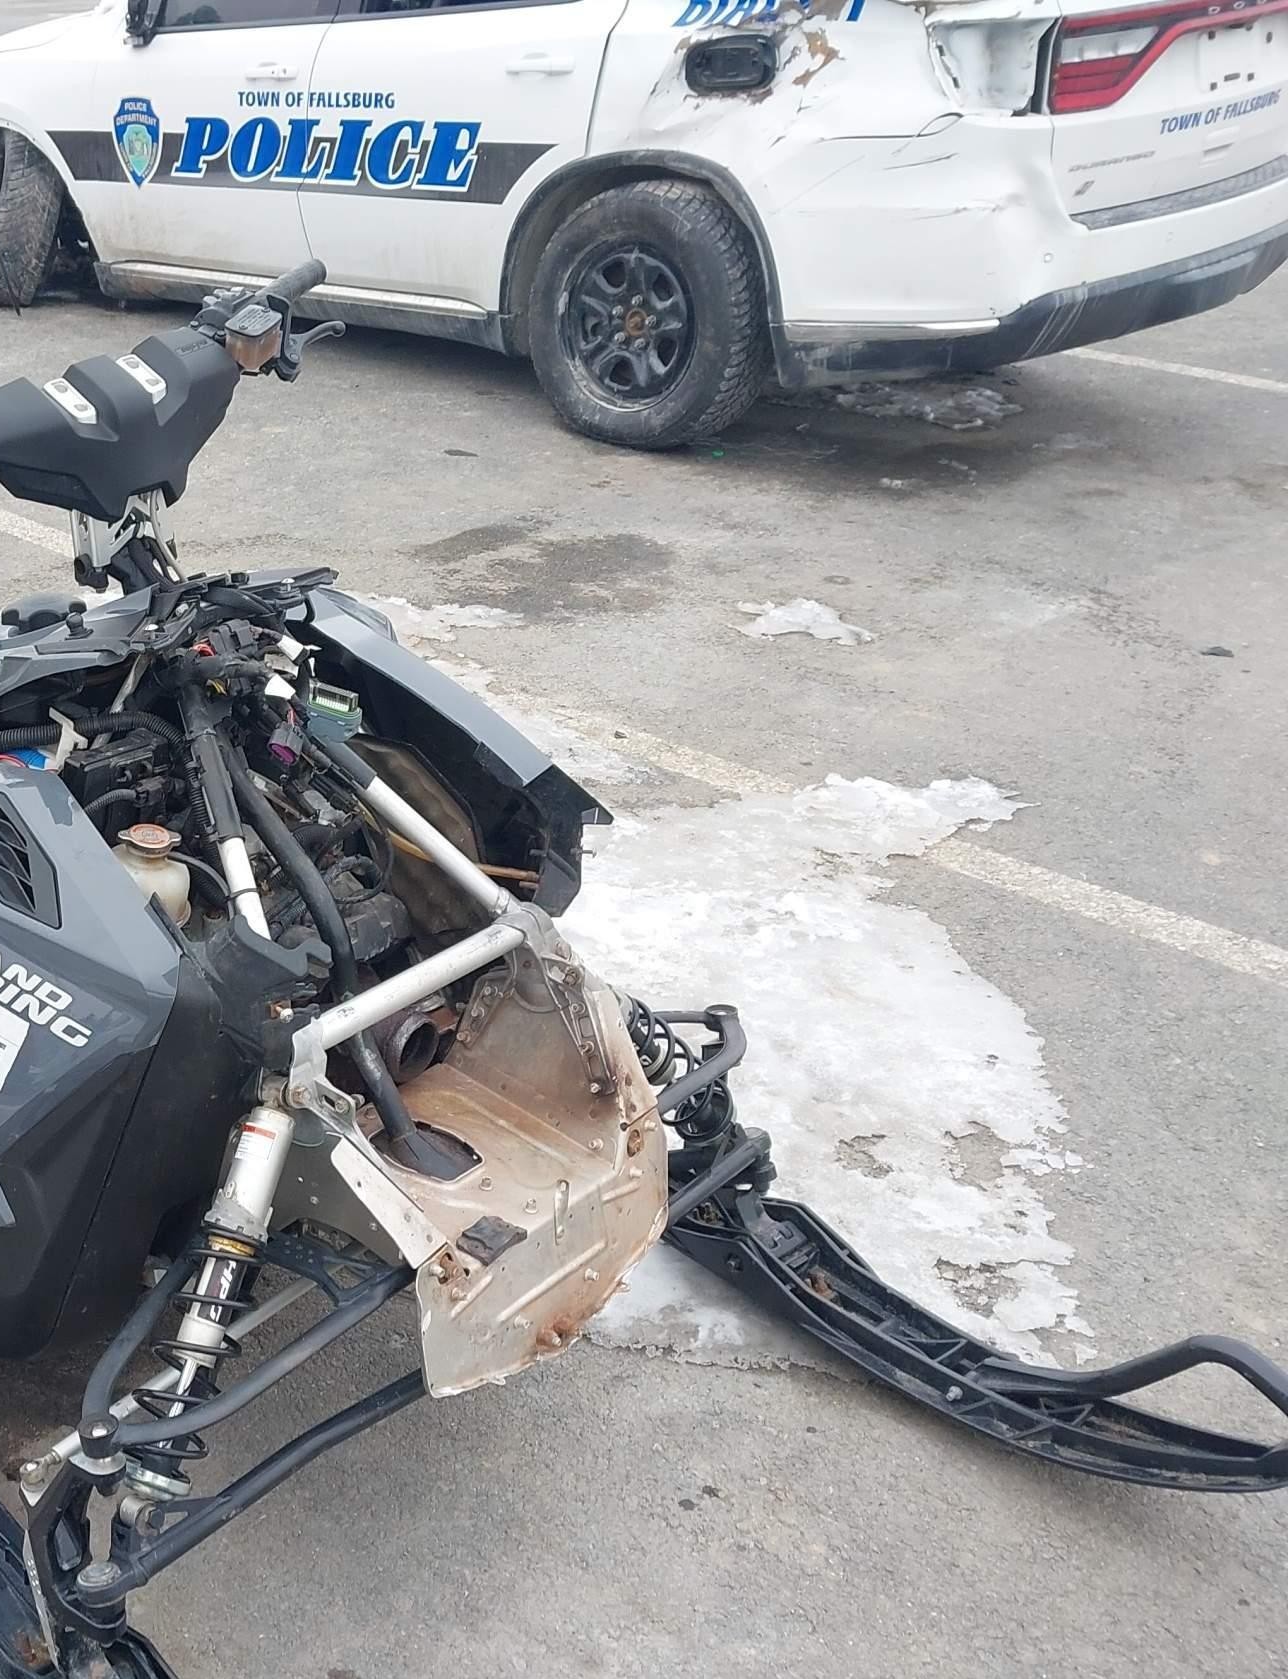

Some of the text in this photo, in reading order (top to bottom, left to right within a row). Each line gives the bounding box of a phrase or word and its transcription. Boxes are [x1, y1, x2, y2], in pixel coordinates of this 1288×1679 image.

[123, 101, 148, 112] POLICE
[237, 91, 396, 110] TOWN OF FALLSBURG
[115, 112, 157, 127] DEPARTMENT
[1160, 89, 1282, 135] TOWN OF FALLSBURG
[173, 116, 483, 191] POLICE
